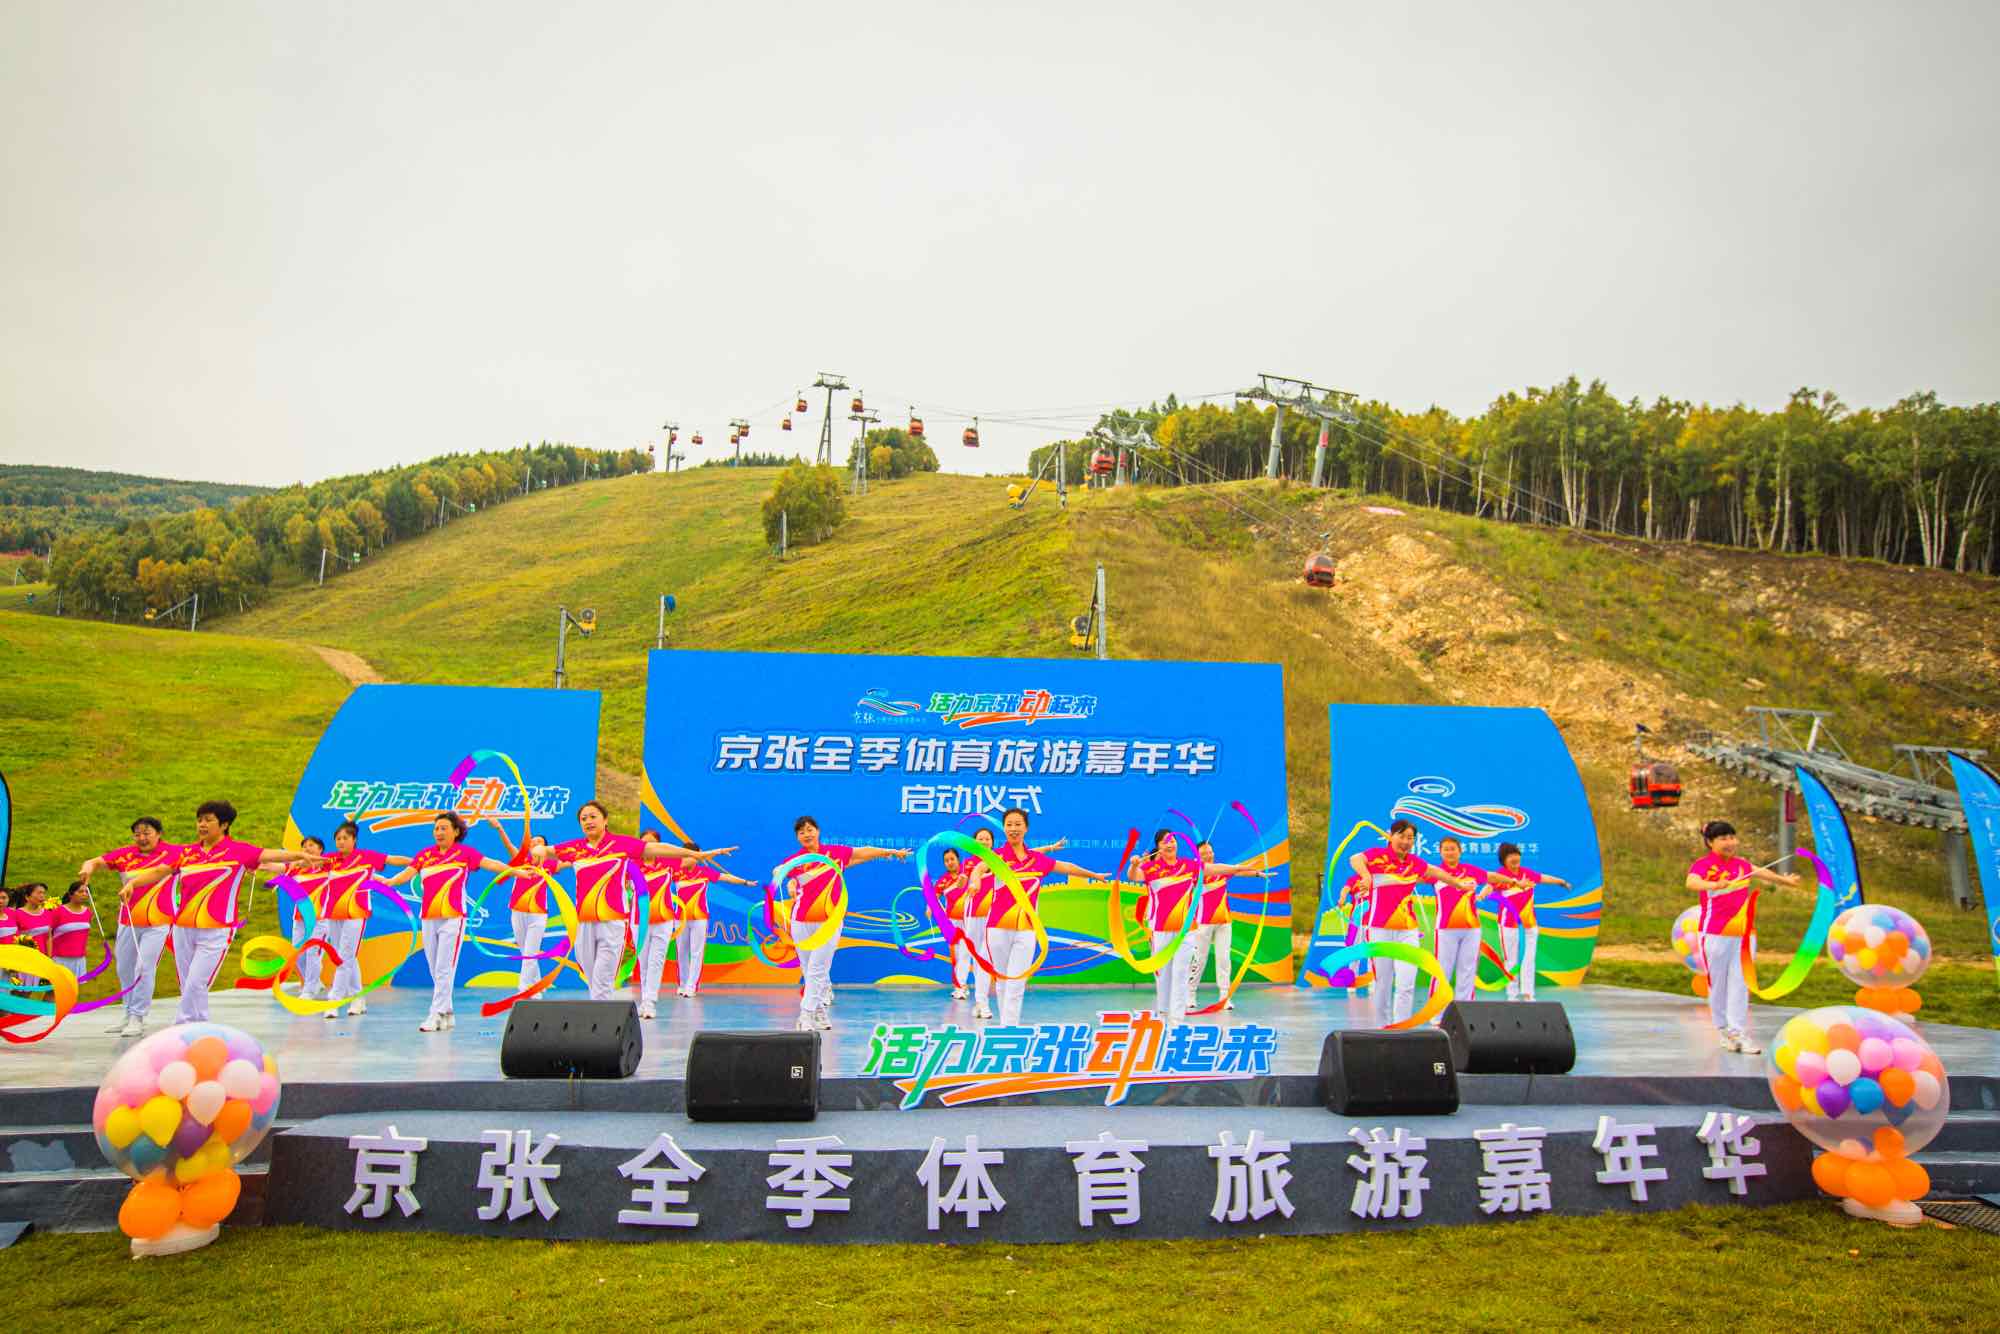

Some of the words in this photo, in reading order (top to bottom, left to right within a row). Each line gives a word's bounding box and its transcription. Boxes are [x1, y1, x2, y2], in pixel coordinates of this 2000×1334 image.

[926, 690, 1097, 726] 活力京张动起来
[715, 735, 1218, 775] 京张全季体育旅游嘉年华
[322, 777, 570, 827] 活力京张动起来
[900, 784, 1044, 814] 启动仪式
[863, 1010, 1278, 1108] 活力京张动起来
[344, 1112, 1767, 1229] 京张全季体育旅游嘉年华
